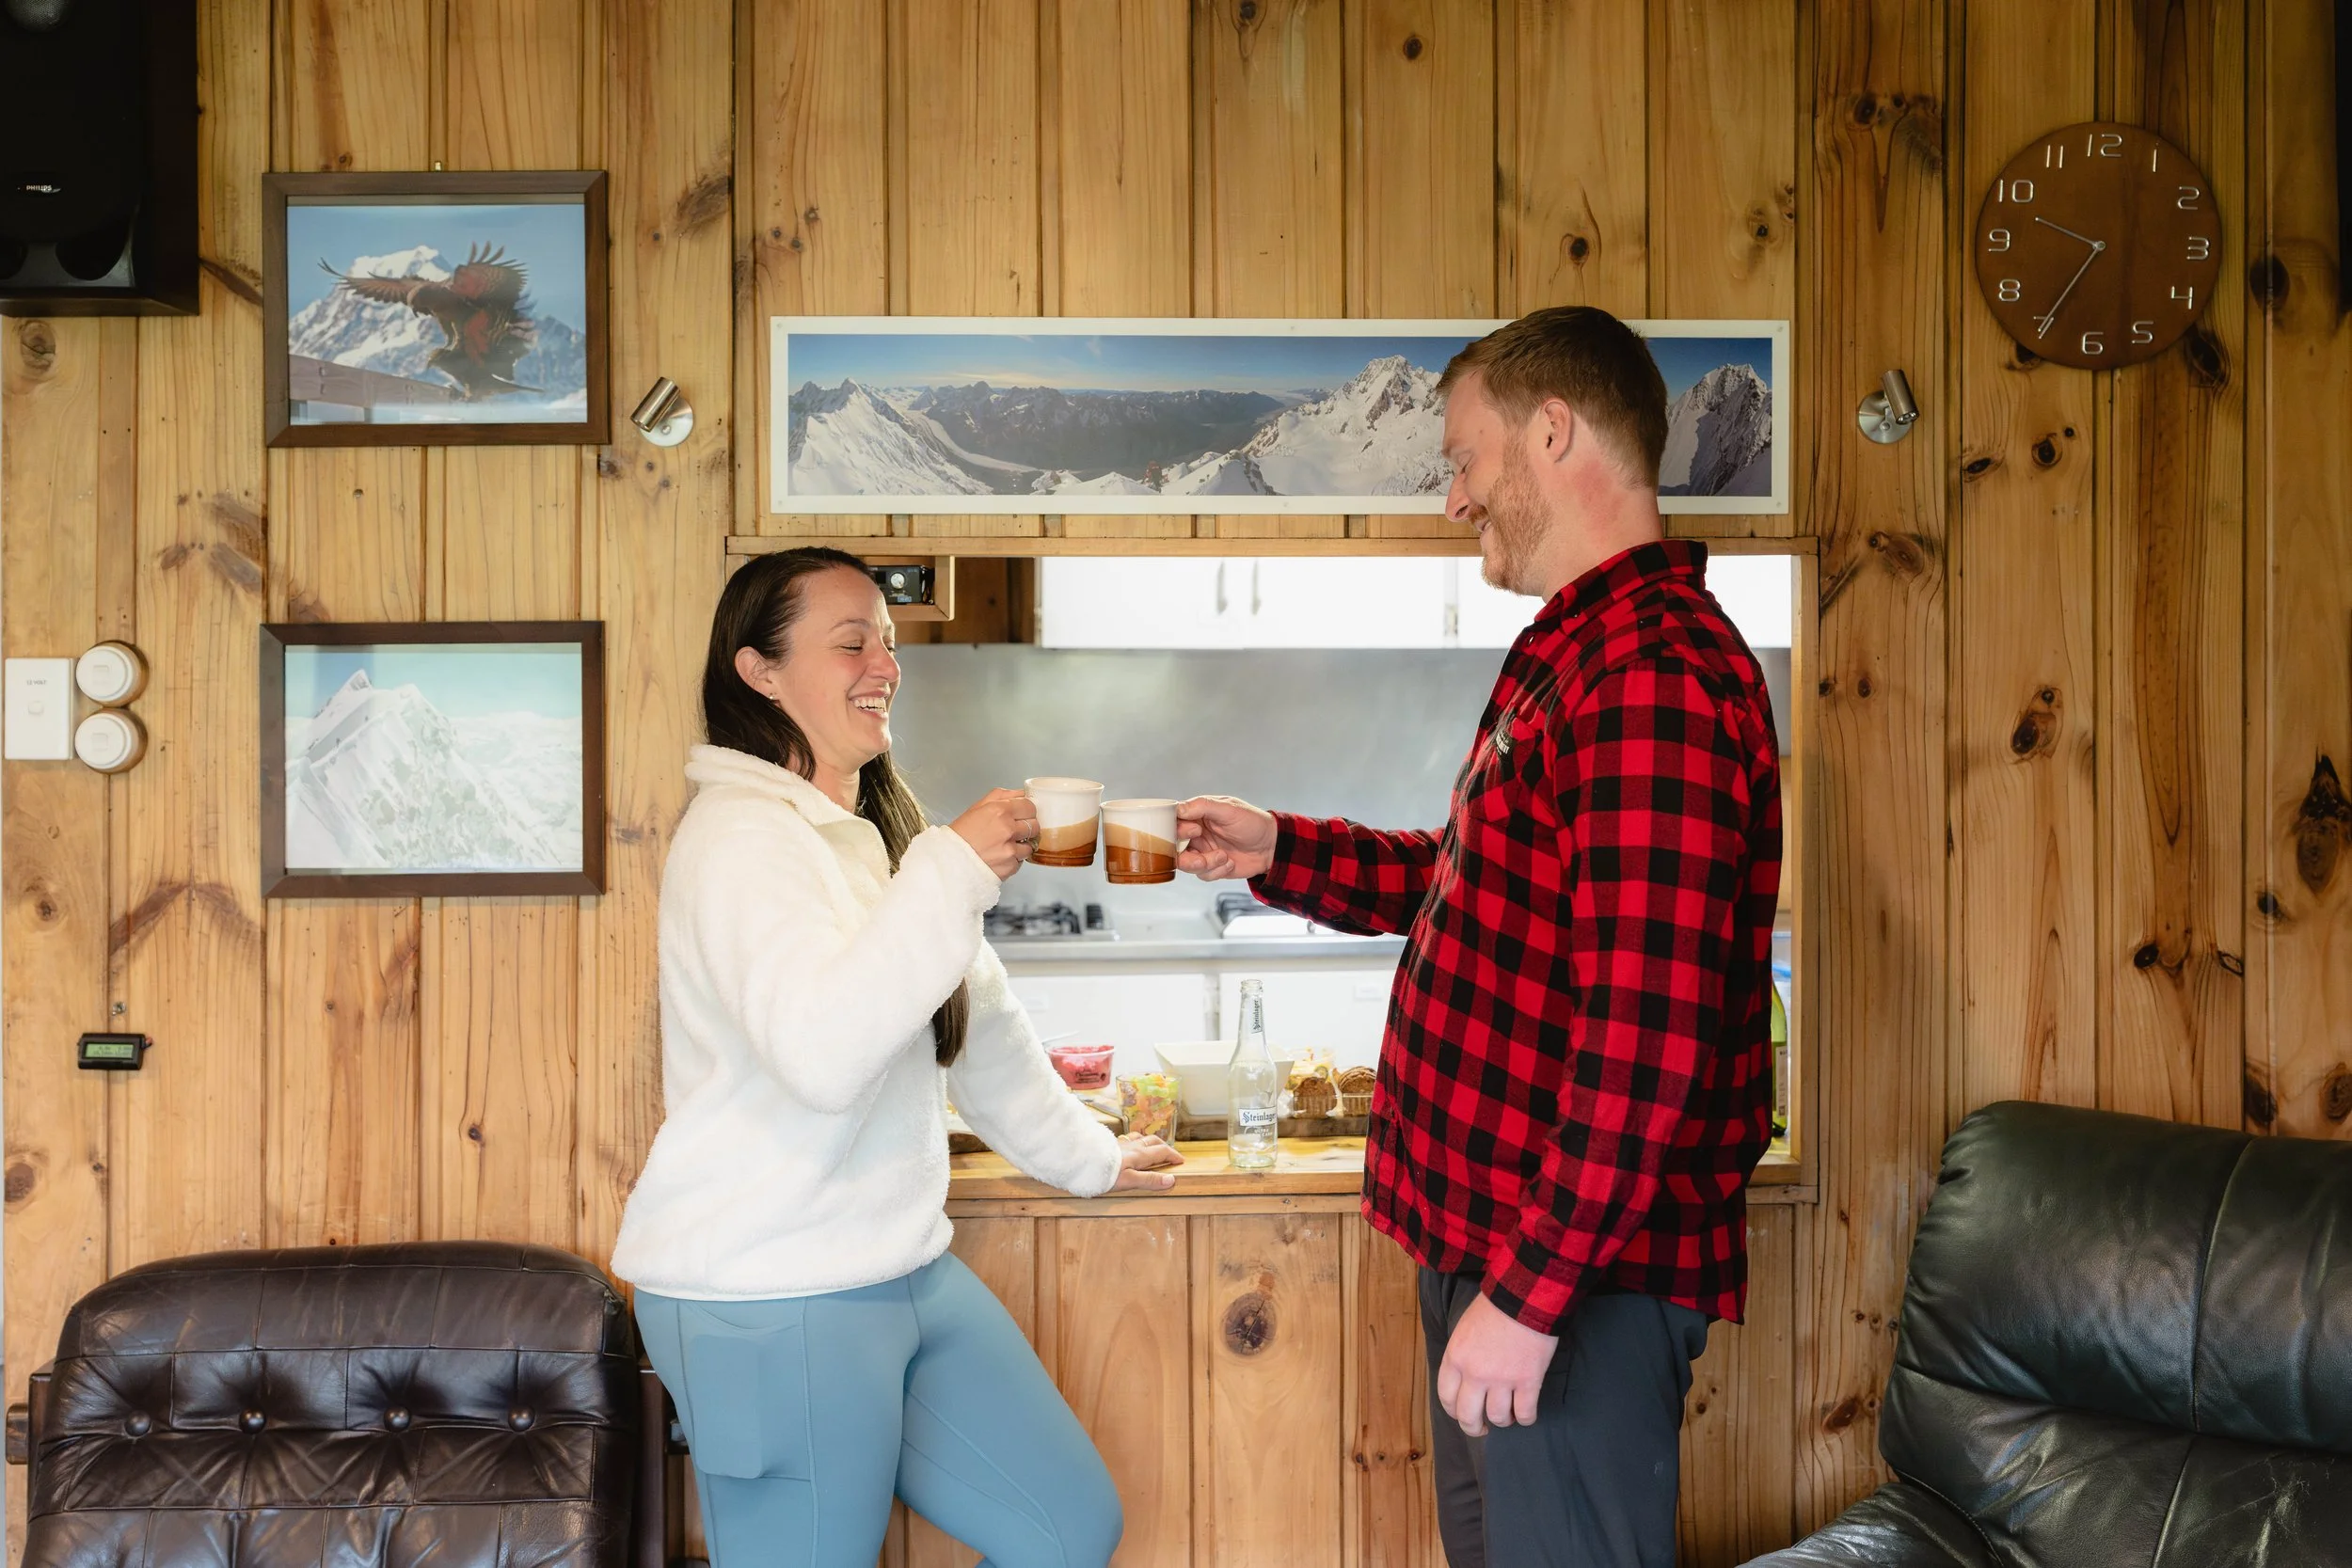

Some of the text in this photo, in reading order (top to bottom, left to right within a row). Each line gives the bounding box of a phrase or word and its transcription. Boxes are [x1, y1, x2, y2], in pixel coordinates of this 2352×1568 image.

[2045, 144, 2064, 169] 11
[2087, 134, 2122, 157] 12
[2152, 148, 2158, 173] 1
[1998, 179, 2034, 203] 10
[2177, 185, 2200, 210] 2
[1988, 229, 2010, 252] 9
[2186, 236, 2210, 261] 3
[1998, 278, 2021, 302] 8
[2170, 285, 2194, 310] 4
[2033, 315, 2055, 340] 7
[2131, 321, 2154, 344] 5
[2081, 331, 2105, 356] 6
[1252, 1000, 1261, 1031] Steinlager
